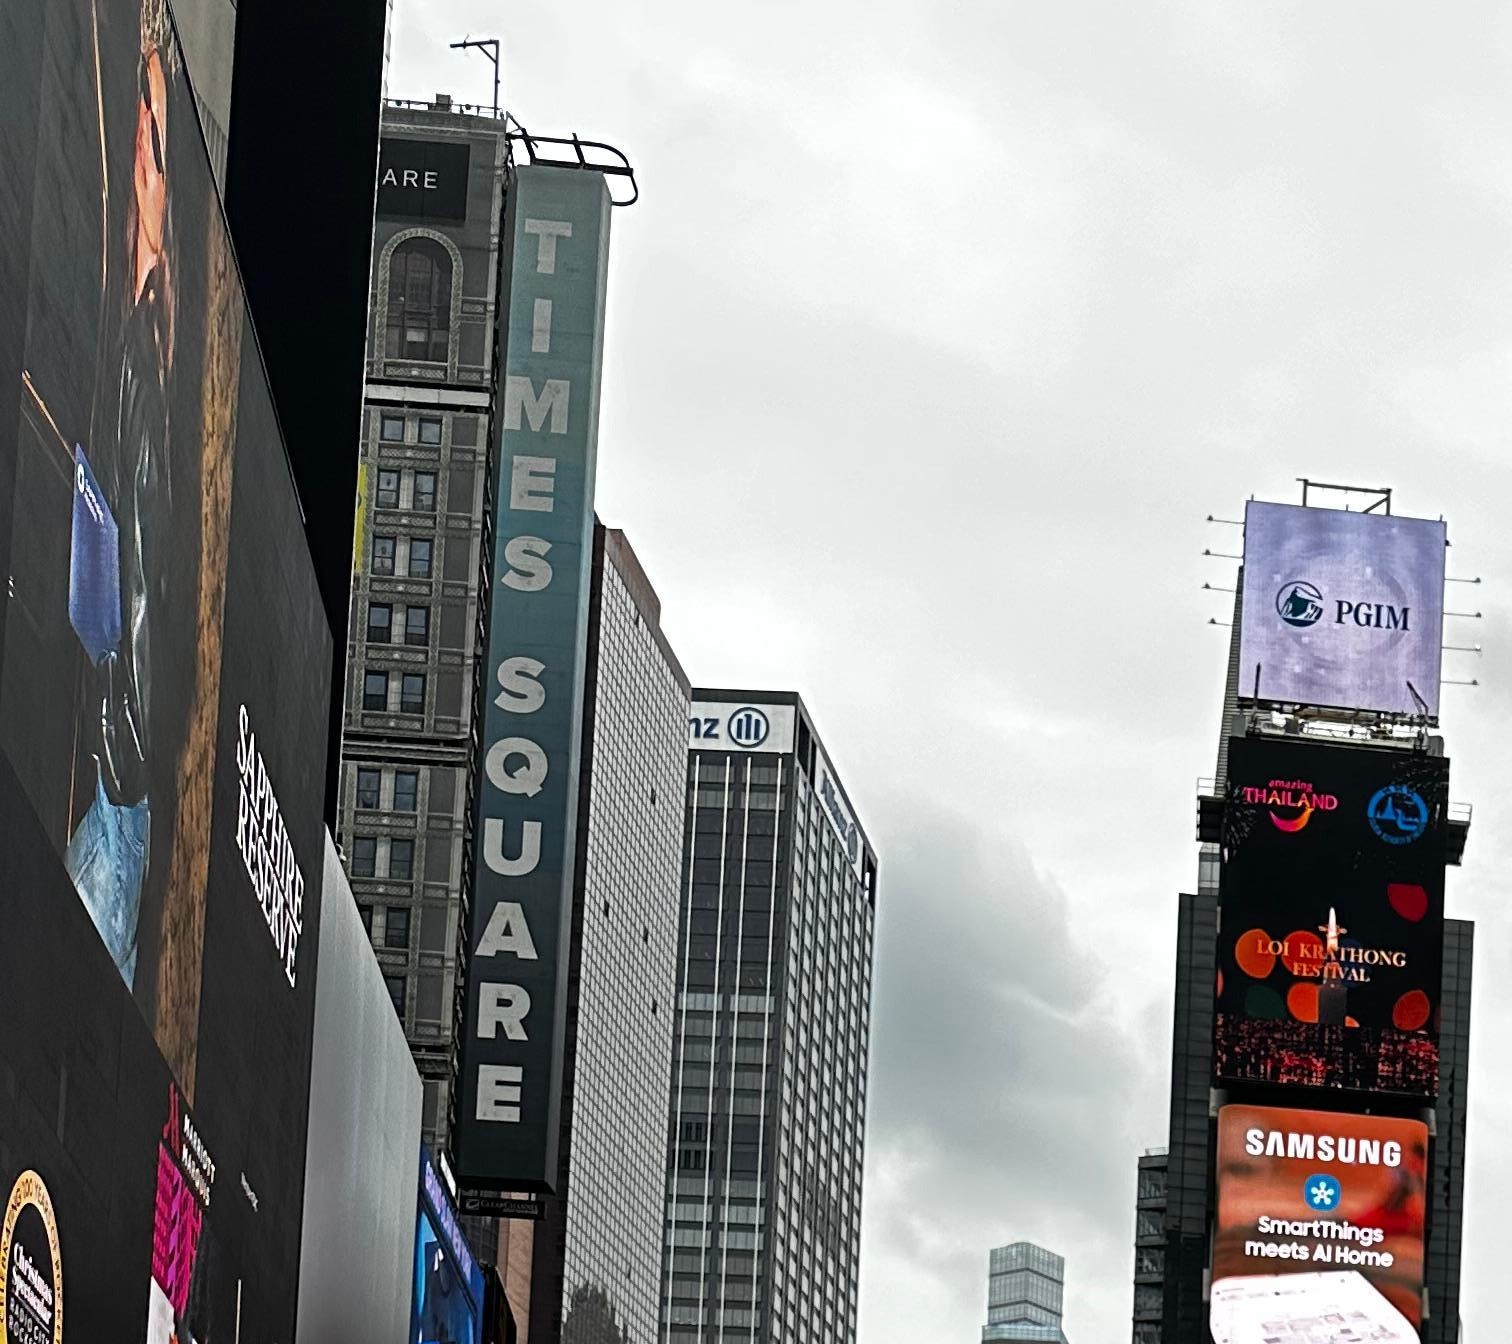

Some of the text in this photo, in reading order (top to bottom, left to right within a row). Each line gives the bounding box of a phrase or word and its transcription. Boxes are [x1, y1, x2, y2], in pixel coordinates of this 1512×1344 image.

[501, 218, 573, 592] TIMES
[1336, 599, 1410, 631] PGIM
[1243, 786, 1339, 810] THAILAND
[1268, 778, 1314, 791] amazing
[237, 704, 304, 935] SAPPHIRE
[236, 778, 298, 989] RESERVE
[475, 656, 549, 1122] SQUARE
[1256, 939, 1407, 968] LOI KRATHONG
[1292, 961, 1371, 983] FESTIVAL
[1245, 1128, 1402, 1168] SAMSUNG
[1257, 1215, 1384, 1247] SmartThings
[1244, 1239, 1395, 1268] meets AI Home
